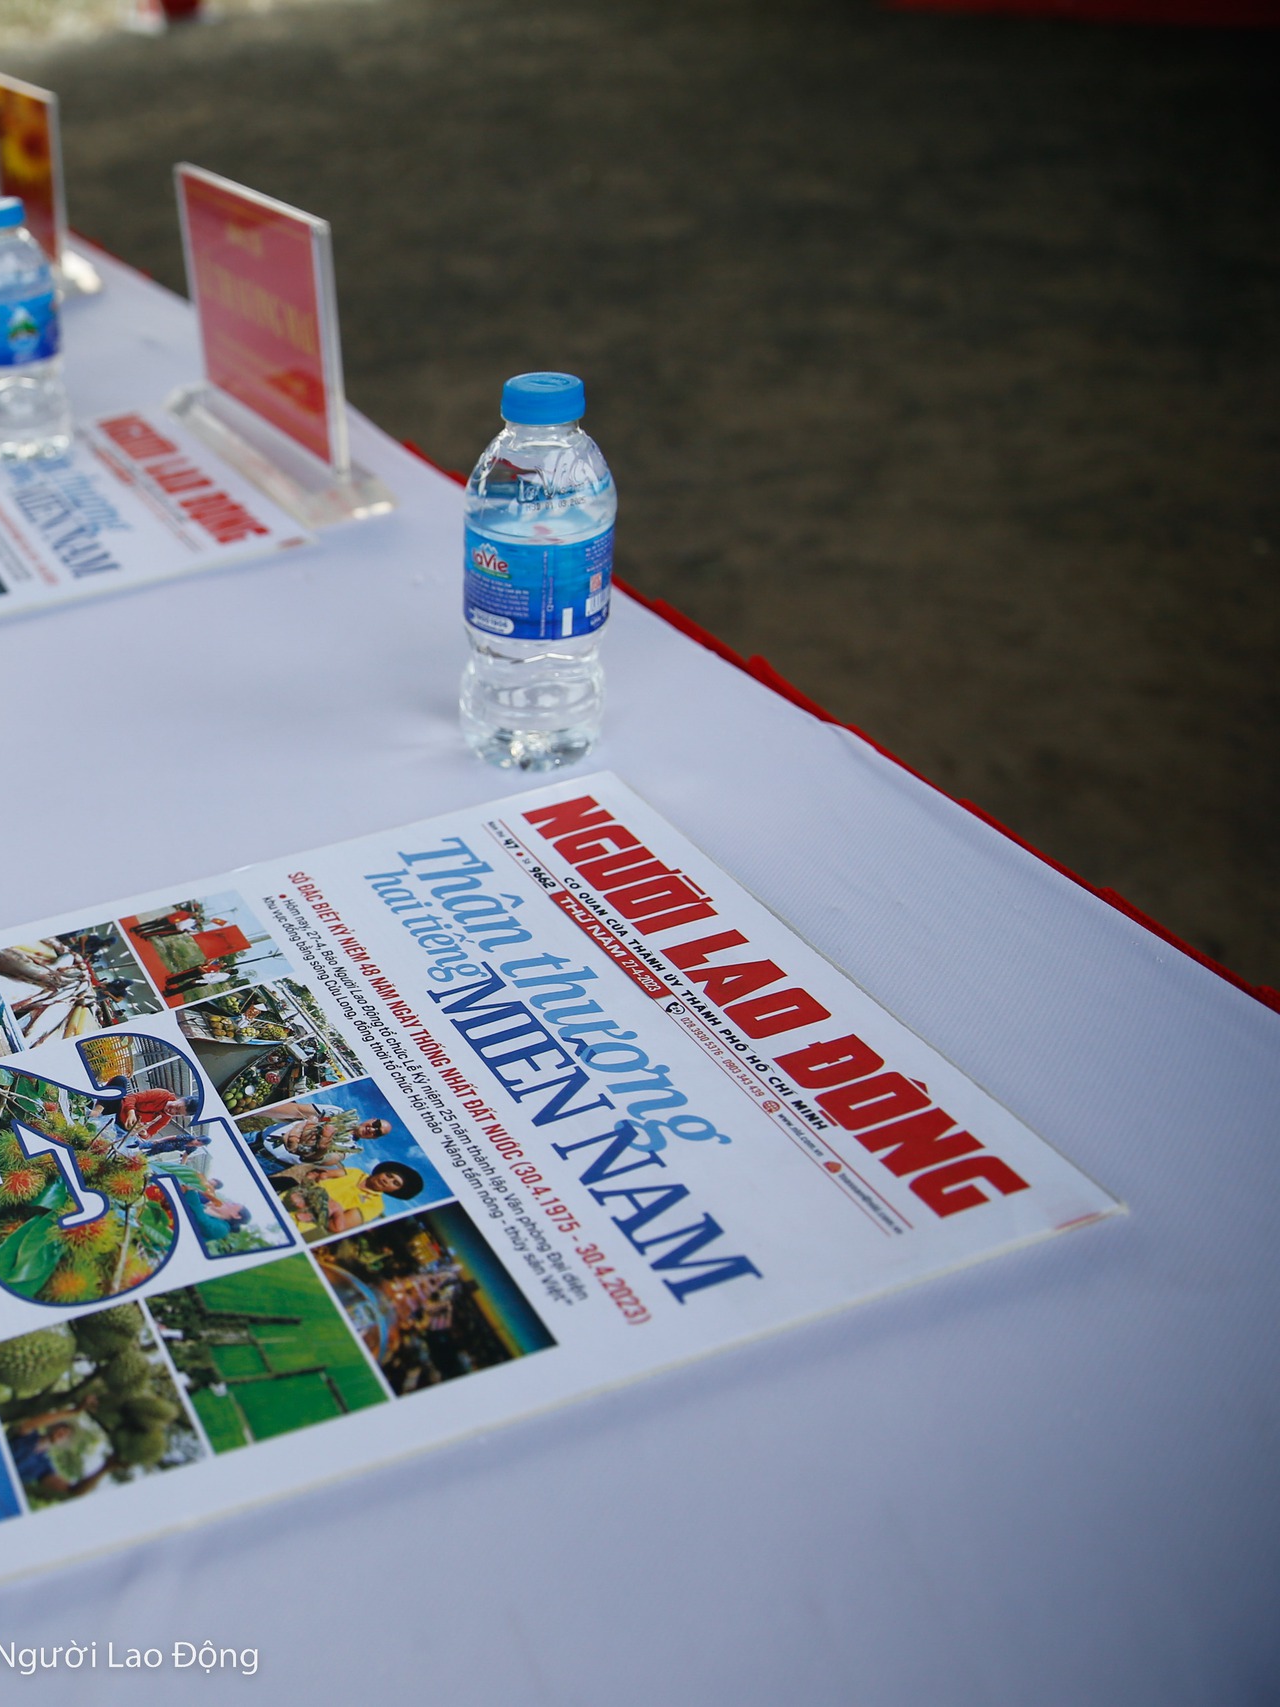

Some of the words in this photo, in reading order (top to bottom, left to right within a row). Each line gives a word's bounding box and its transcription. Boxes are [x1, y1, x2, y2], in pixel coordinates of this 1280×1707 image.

[503, 838, 519, 848] 47
[528, 866, 556, 888] 9662
[287, 871, 310, 884] SỐ
[262, 895, 277, 910] khu
[296, 883, 323, 902] ĐẶC
[363, 868, 432, 915] hai
[272, 909, 287, 923] vực
[282, 898, 300, 916] Hôm
[311, 902, 340, 922] BIỆT
[281, 923, 301, 941] đồng
[294, 916, 310, 931] nay,
[327, 923, 354, 935] KỶ
[295, 940, 315, 961] bằng
[305, 930, 326, 950] 27-4,
[337, 936, 370, 962] NIỆM
[402, 914, 487, 982] tiếng
[560, 895, 595, 923] THỨ
[586, 924, 627, 957] NĂM
[621, 959, 661, 991] 27-4-2023
[320, 950, 337, 965] Báo
[309, 960, 329, 980] sông
[332, 966, 359, 989] Người
[358, 963, 380, 976] 48
[324, 979, 341, 996] Cửu
[349, 989, 367, 1004] Lao
[367, 976, 399, 1000] NĂM
[397, 836, 532, 953] Thân
[476, 952, 731, 1152] thương
[335, 995, 356, 1020] Long,
[385, 1000, 422, 1028] NGÀY
[521, 795, 718, 936] NGƯỜI
[659, 928, 831, 1039] LAO
[771, 1033, 1030, 1218] ĐỘNG
[563, 877, 581, 889] CƠ
[578, 892, 608, 916] QUAN
[605, 918, 628, 937] CỦA
[627, 938, 666, 971] THÀNH
[663, 973, 683, 986] ỦY
[680, 989, 721, 1026] THÀNH
[718, 1028, 752, 1051] PHỐ
[745, 1055, 774, 1072] HỒ
[768, 1076, 793, 1096] CHÍ
[790, 1099, 827, 1130] MINH
[361, 1005, 384, 1027] Động
[353, 1020, 374, 1042] đồng
[378, 1026, 395, 1037] tổ
[369, 1041, 391, 1060] thời
[385, 1037, 407, 1059] chức
[409, 1028, 450, 1067] THỐNG
[426, 961, 614, 1126] MIỀN
[382, 1060, 401, 1070] tổ
[401, 1059, 421, 1071] Lễ
[390, 1071, 413, 1094] chức
[411, 1071, 430, 1083] Kỷ
[437, 1067, 476, 1097] NHẤT
[407, 1094, 429, 1111] Hội
[420, 1085, 444, 1108] niệm
[438, 1108, 457, 1121] 25
[462, 1098, 496, 1122] ĐẤT
[420, 1111, 442, 1134] thảo
[448, 1122, 471, 1144] năm
[481, 1123, 523, 1160] NƯỚC
[466, 1145, 495, 1175] thành
[461, 1167, 482, 1189] tầm
[488, 1175, 507, 1193] lập
[476, 1190, 503, 1219] nông
[503, 1192, 524, 1215] Văn
[508, 1161, 580, 1232] (30.4.1975
[551, 1119, 760, 1303] NAM
[515, 1216, 551, 1252] phòng
[522, 1252, 545, 1275] sản
[546, 1251, 569, 1272] Đại
[561, 1273, 587, 1300] diện
[574, 1243, 650, 1324] 30.4.2023)
